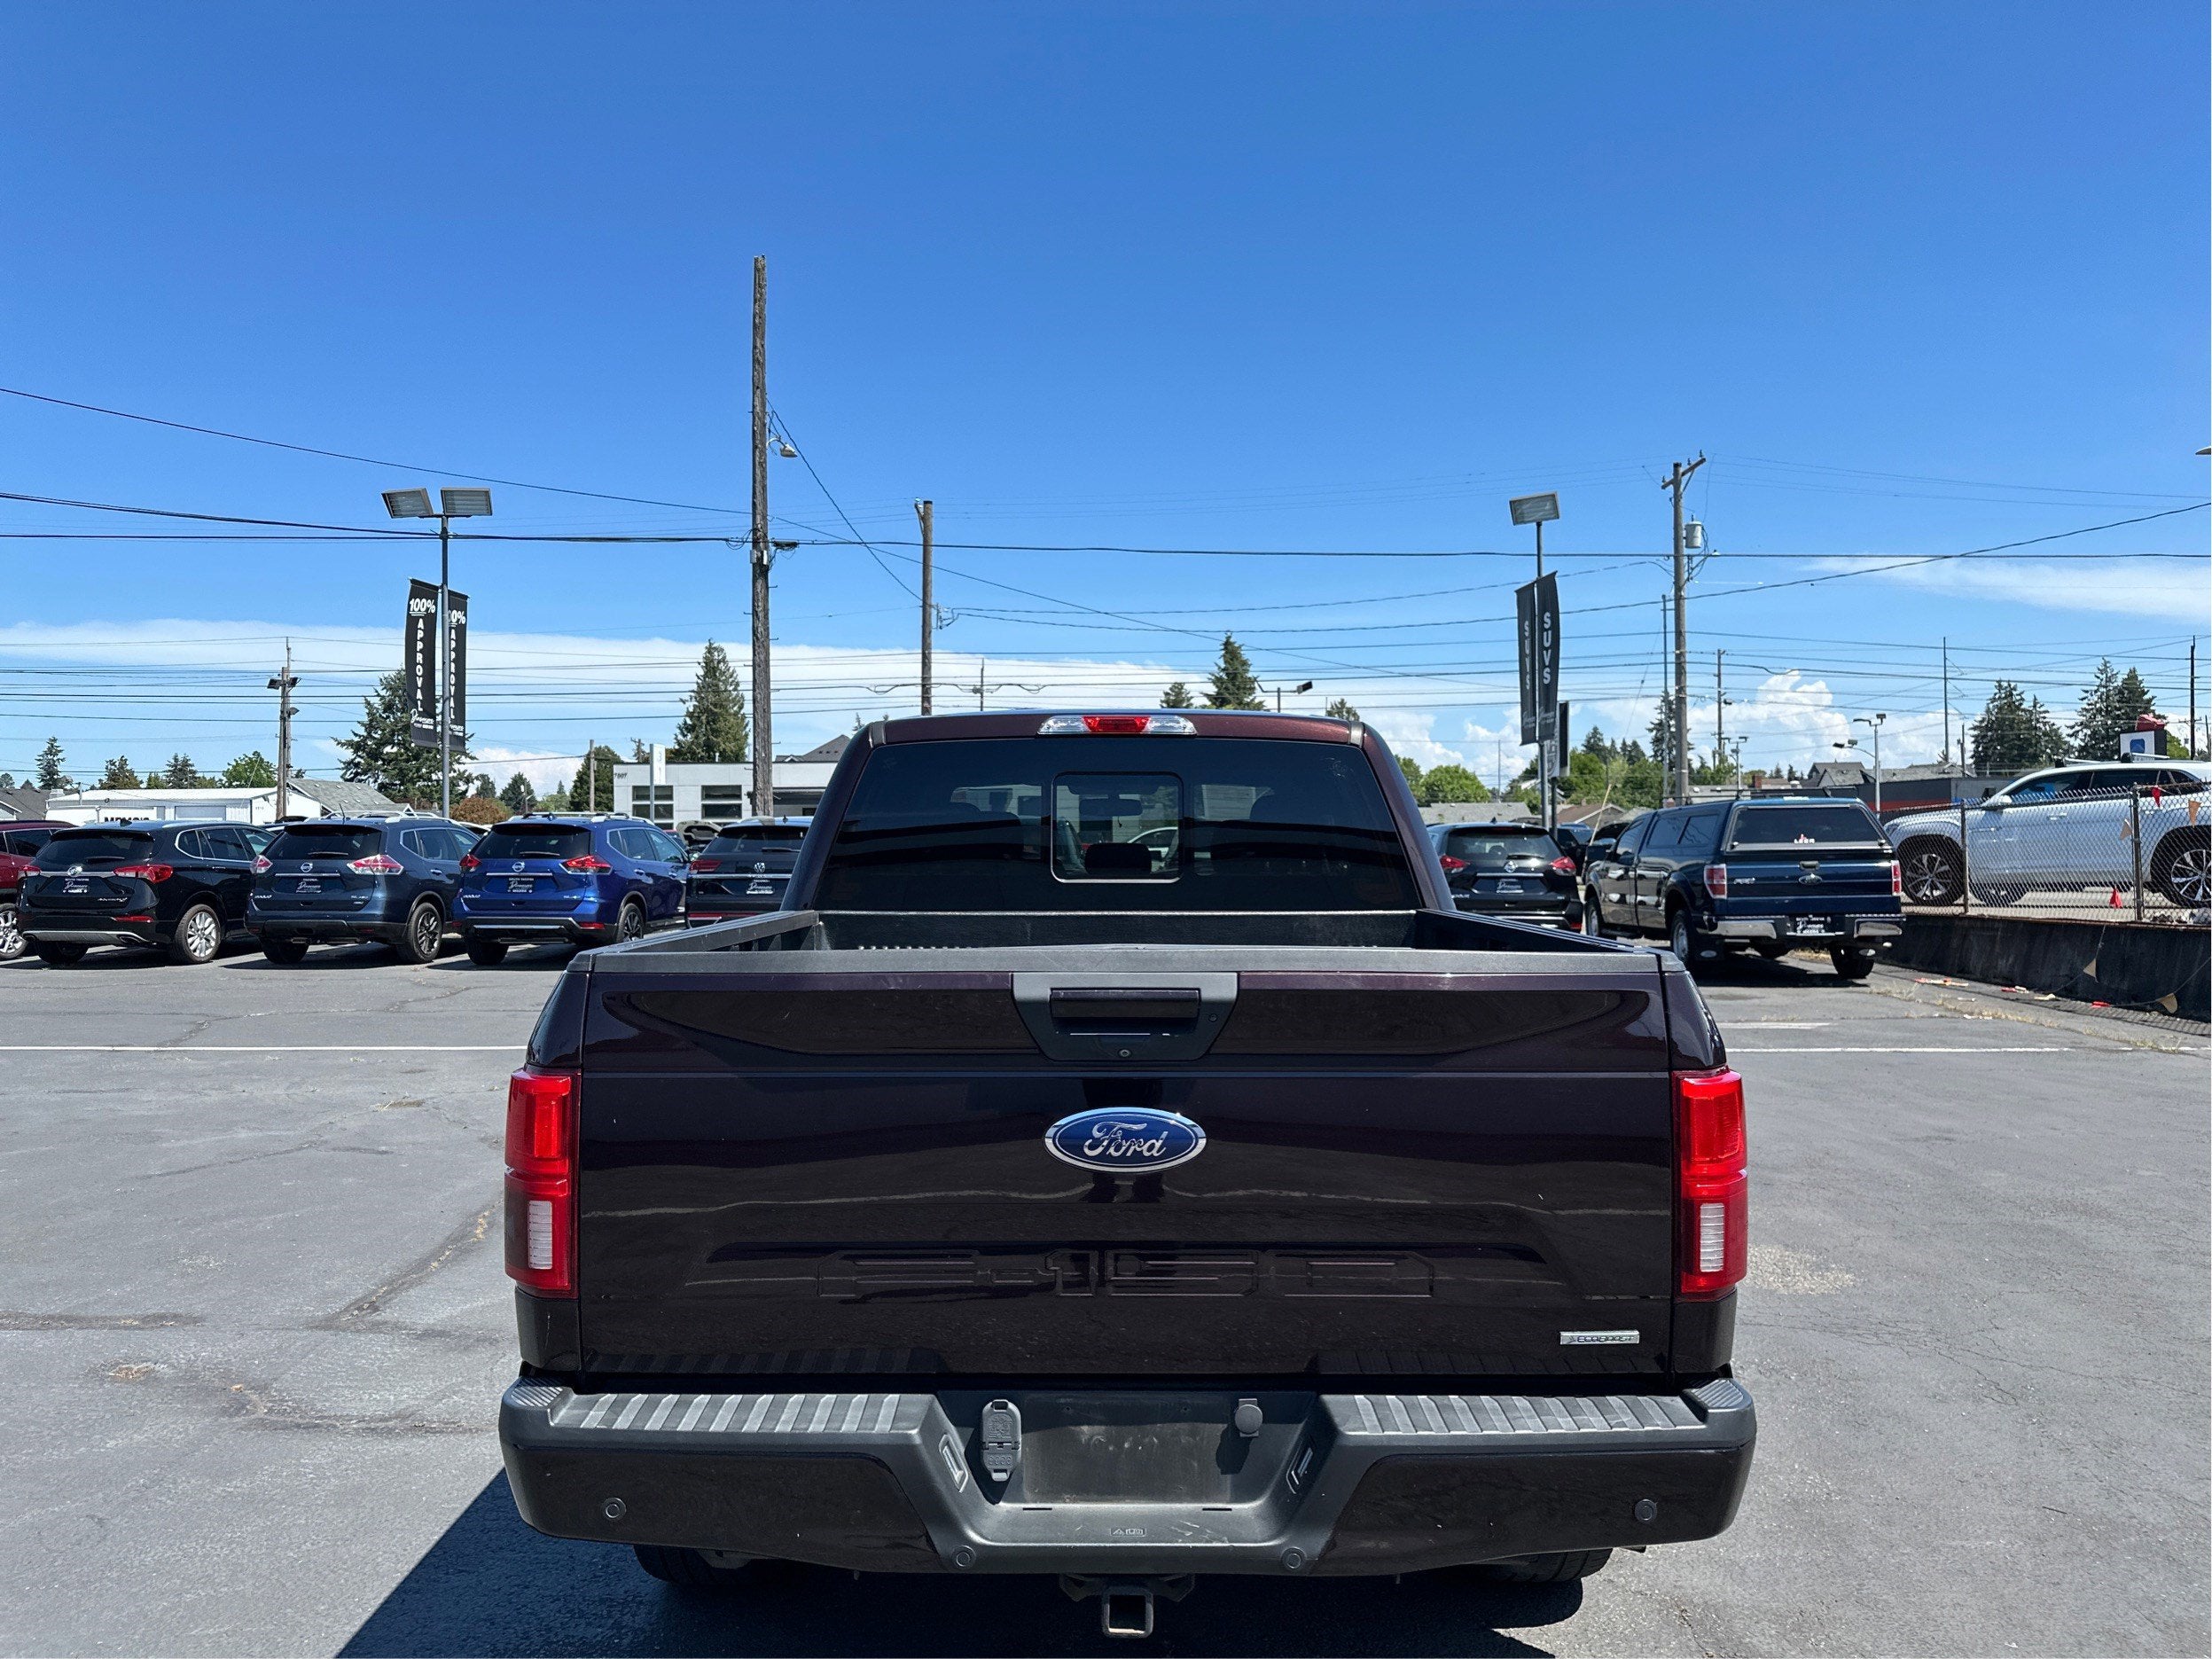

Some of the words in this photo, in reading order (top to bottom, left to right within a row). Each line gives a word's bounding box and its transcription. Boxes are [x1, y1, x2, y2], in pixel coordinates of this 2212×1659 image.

[409, 598, 436, 614] 100%
[448, 609, 466, 625] 0%
[416, 618, 425, 711] APPROVAL
[1543, 611, 1552, 685] SUVS
[1083, 1120, 1169, 1158] Ford
